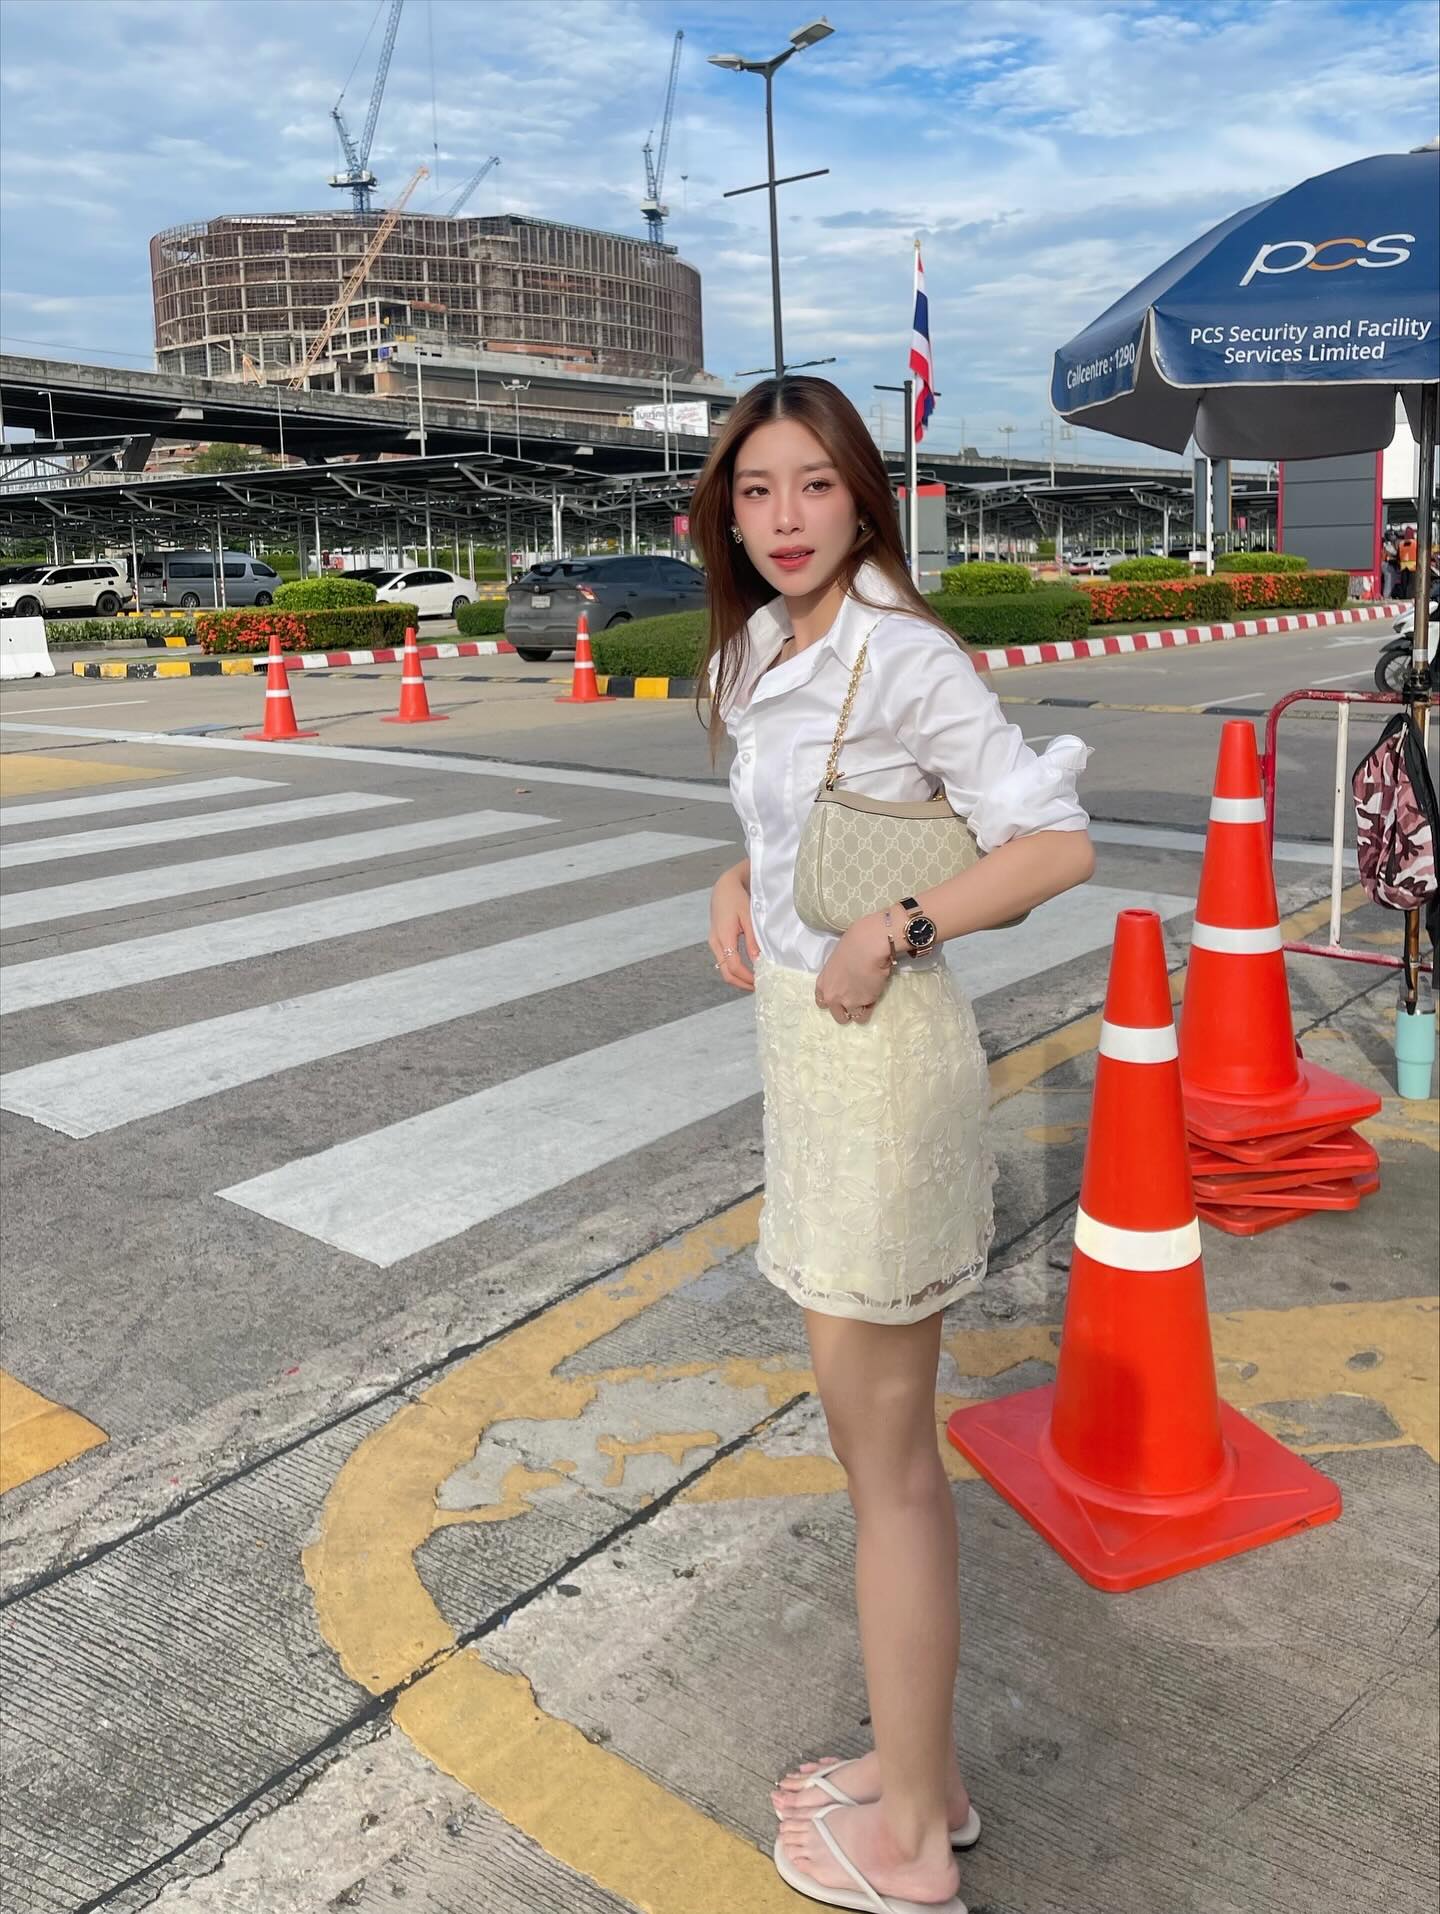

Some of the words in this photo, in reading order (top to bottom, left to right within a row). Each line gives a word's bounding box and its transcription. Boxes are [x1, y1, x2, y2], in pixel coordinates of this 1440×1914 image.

[1190, 326, 1224, 344] PCS
[1228, 323, 1306, 344] Security
[1312, 320, 1352, 340] and
[1357, 318, 1432, 341] Facility
[1114, 342, 1135, 369] 1290
[1224, 345, 1302, 364] Services
[1309, 341, 1386, 362] Limited
